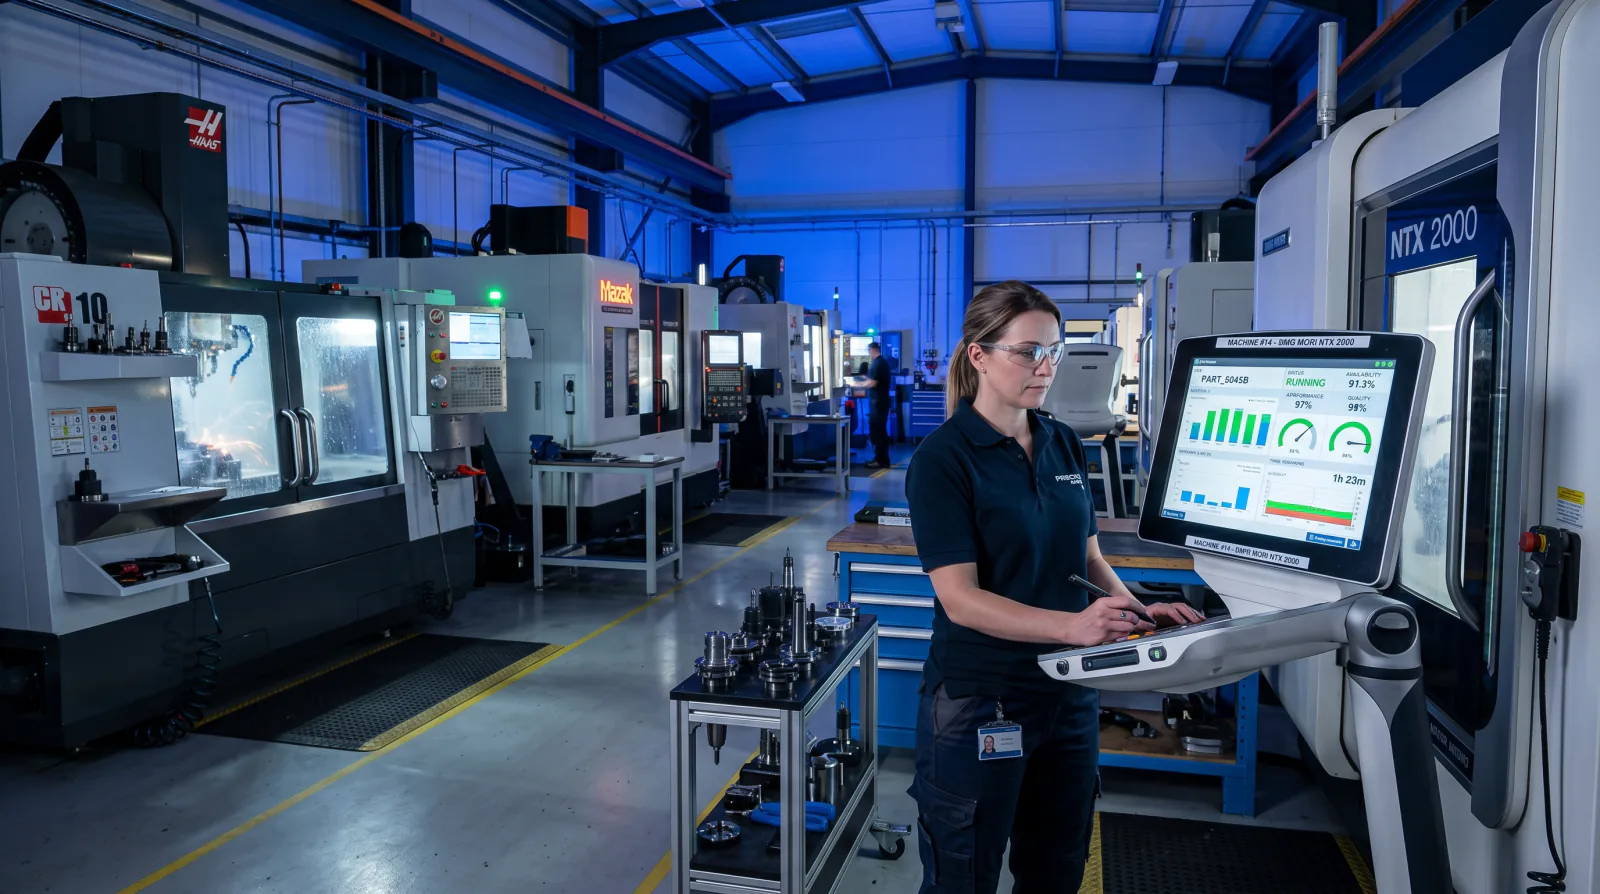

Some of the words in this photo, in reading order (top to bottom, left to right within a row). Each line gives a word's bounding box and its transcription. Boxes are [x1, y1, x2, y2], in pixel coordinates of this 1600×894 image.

[189, 135, 221, 150] HAAS
[1390, 220, 1425, 260] NTX
[1430, 205, 1478, 250] 2000
[600, 279, 633, 305] Mazak
[33, 286, 66, 312] CR
[76, 291, 108, 324] 10
[1227, 338, 1259, 346] MACHINE
[1260, 338, 1273, 346] #14
[1297, 338, 1318, 346] MORI
[1318, 338, 1335, 346] NTX
[1335, 338, 1355, 346] 2000
[1201, 375, 1249, 385] PART_5045B
[1285, 377, 1326, 388] RUNNING
[1348, 379, 1376, 389] 91.3%
[1294, 400, 1313, 410] 97%
[1332, 473, 1344, 483] 1h
[1345, 475, 1366, 486] 23m
[1193, 539, 1220, 550] MACHINE
[1251, 550, 1269, 559] MORI
[1269, 553, 1283, 562] NTX
[1283, 556, 1300, 566] 2000
